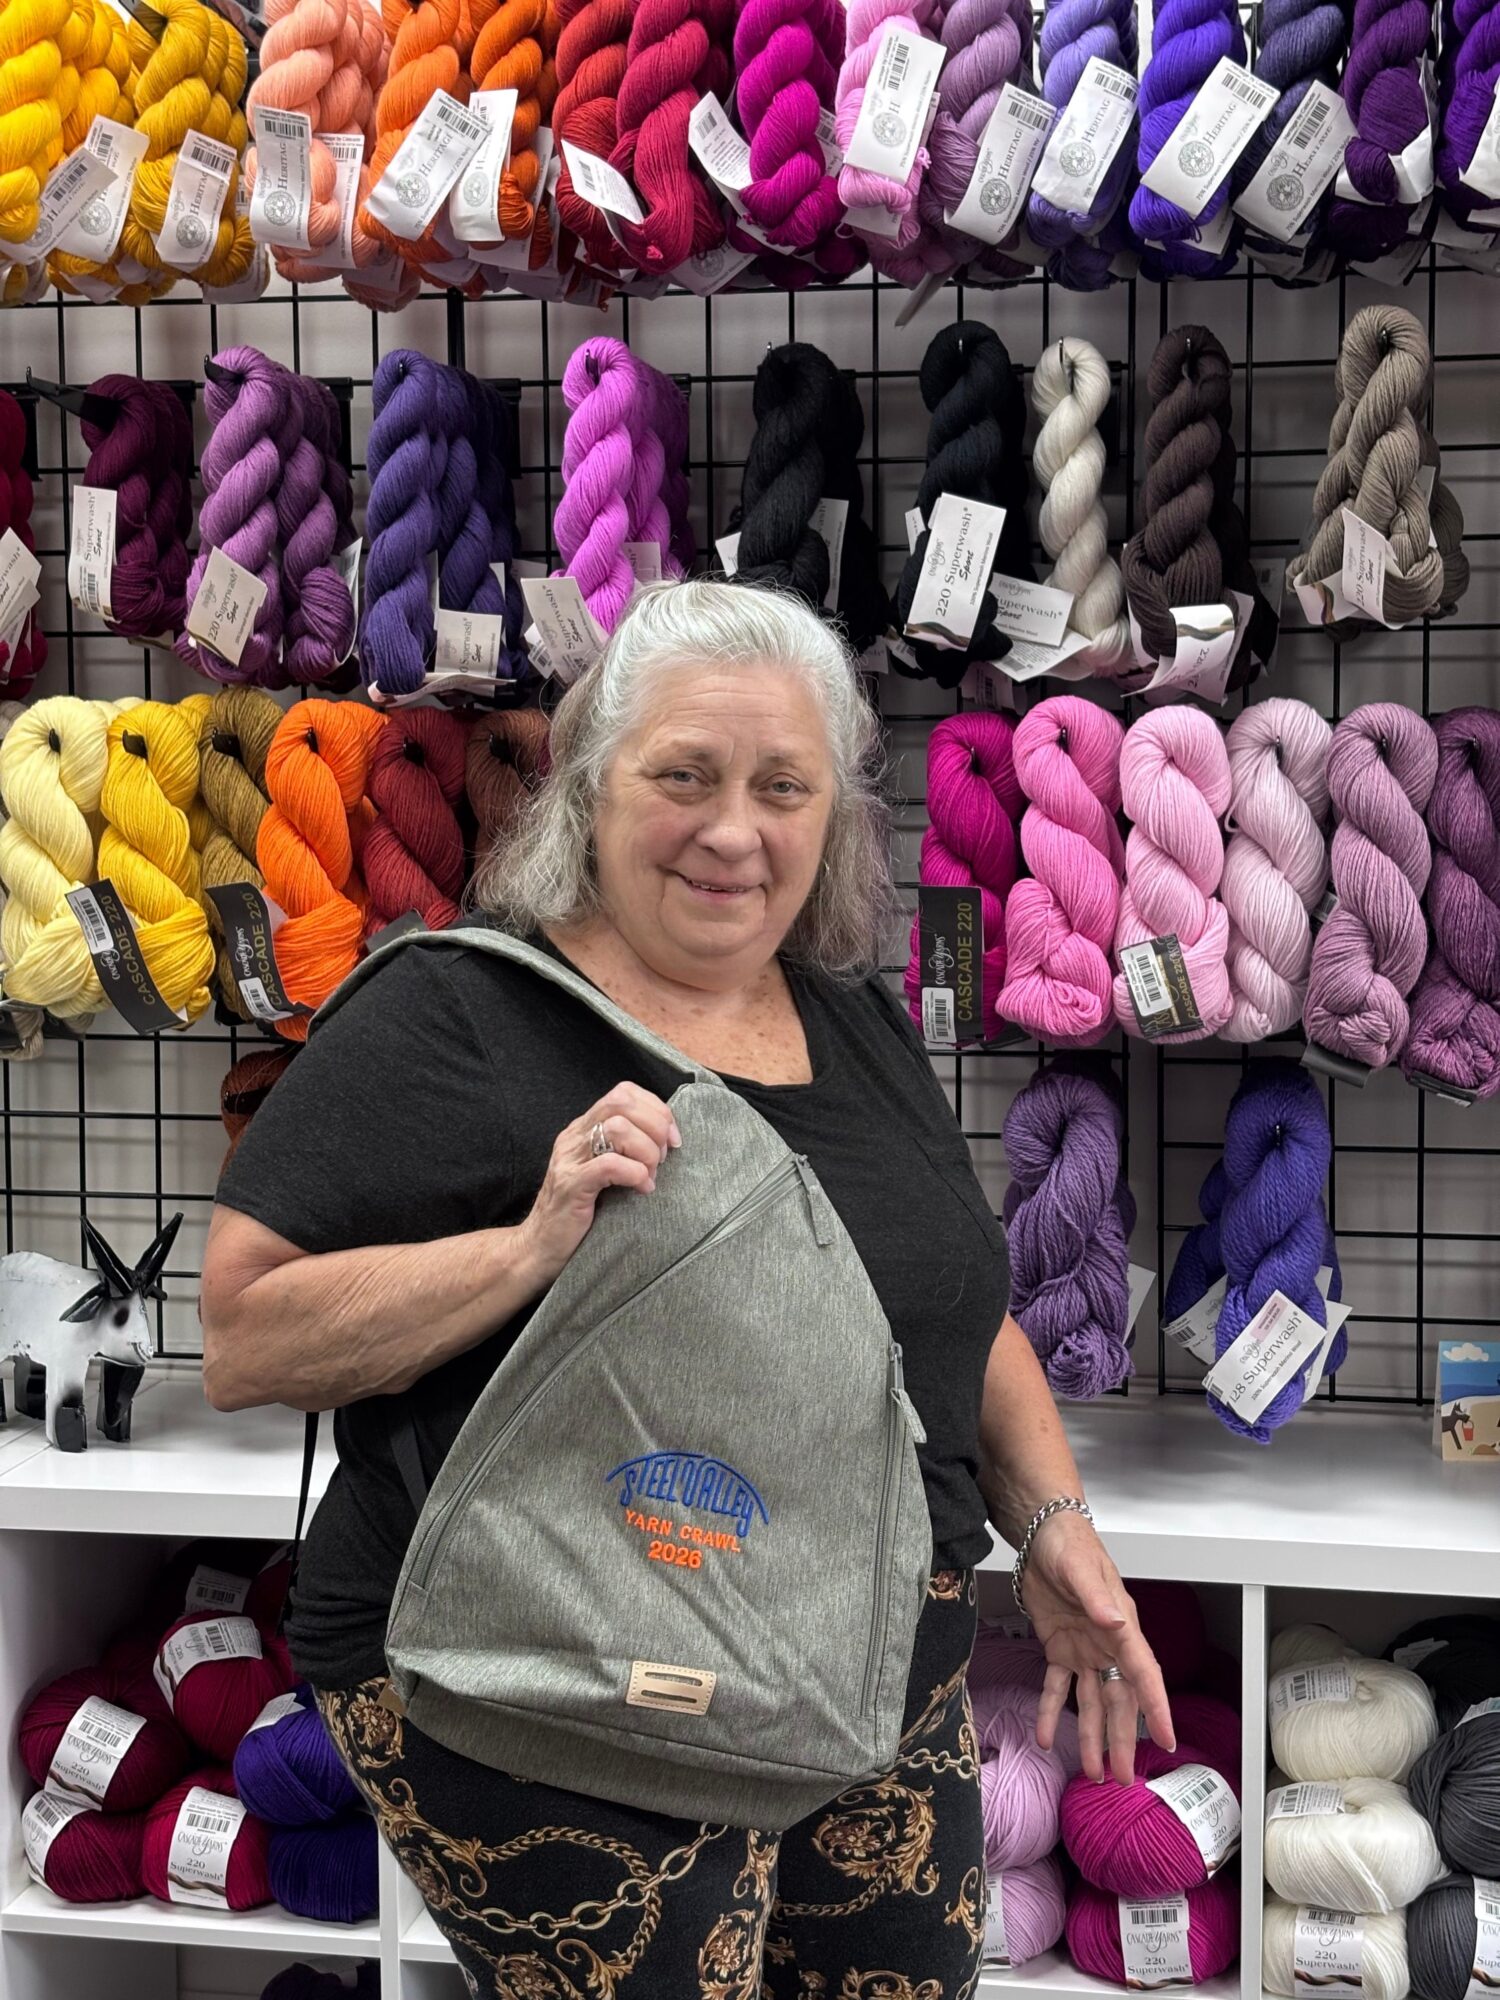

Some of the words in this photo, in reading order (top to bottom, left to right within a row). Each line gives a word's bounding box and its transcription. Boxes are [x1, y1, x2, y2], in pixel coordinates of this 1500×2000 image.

[1081, 96, 1110, 144] HERITAG
[1201, 100, 1237, 145] HERITAG
[276, 142, 290, 189] HERITAG
[996, 128, 1025, 179] HERITAG
[188, 171, 209, 216] HERITAG
[934, 587, 952, 617] 220
[943, 511, 974, 585] Superwash
[957, 549, 976, 581] Sport
[995, 595, 1058, 621] uperwash
[100, 894, 121, 923] 220
[242, 892, 261, 919] 220
[957, 902, 972, 931] 220
[113, 925, 155, 1005] CASCADE
[251, 923, 281, 1006] CASCADE
[957, 936, 972, 1020] CASCADE
[1171, 958, 1182, 974] 220
[1174, 975, 1197, 1019] CASCADE
[1241, 1314, 1302, 1385] Superwash
[619, 1456, 678, 1507] STEEL
[625, 1509, 673, 1536] YARN
[679, 1525, 741, 1553] CRAWL
[648, 1540, 703, 1569] 2026
[70, 1761, 90, 1776] 220
[1209, 1824, 1228, 1842] 220
[170, 1861, 220, 1880] Superwash
[186, 1857, 205, 1868] 220
[1128, 1964, 1185, 1975] Superwash
[1295, 1957, 1355, 1970] Superwash
[1314, 1950, 1336, 1960] 220
